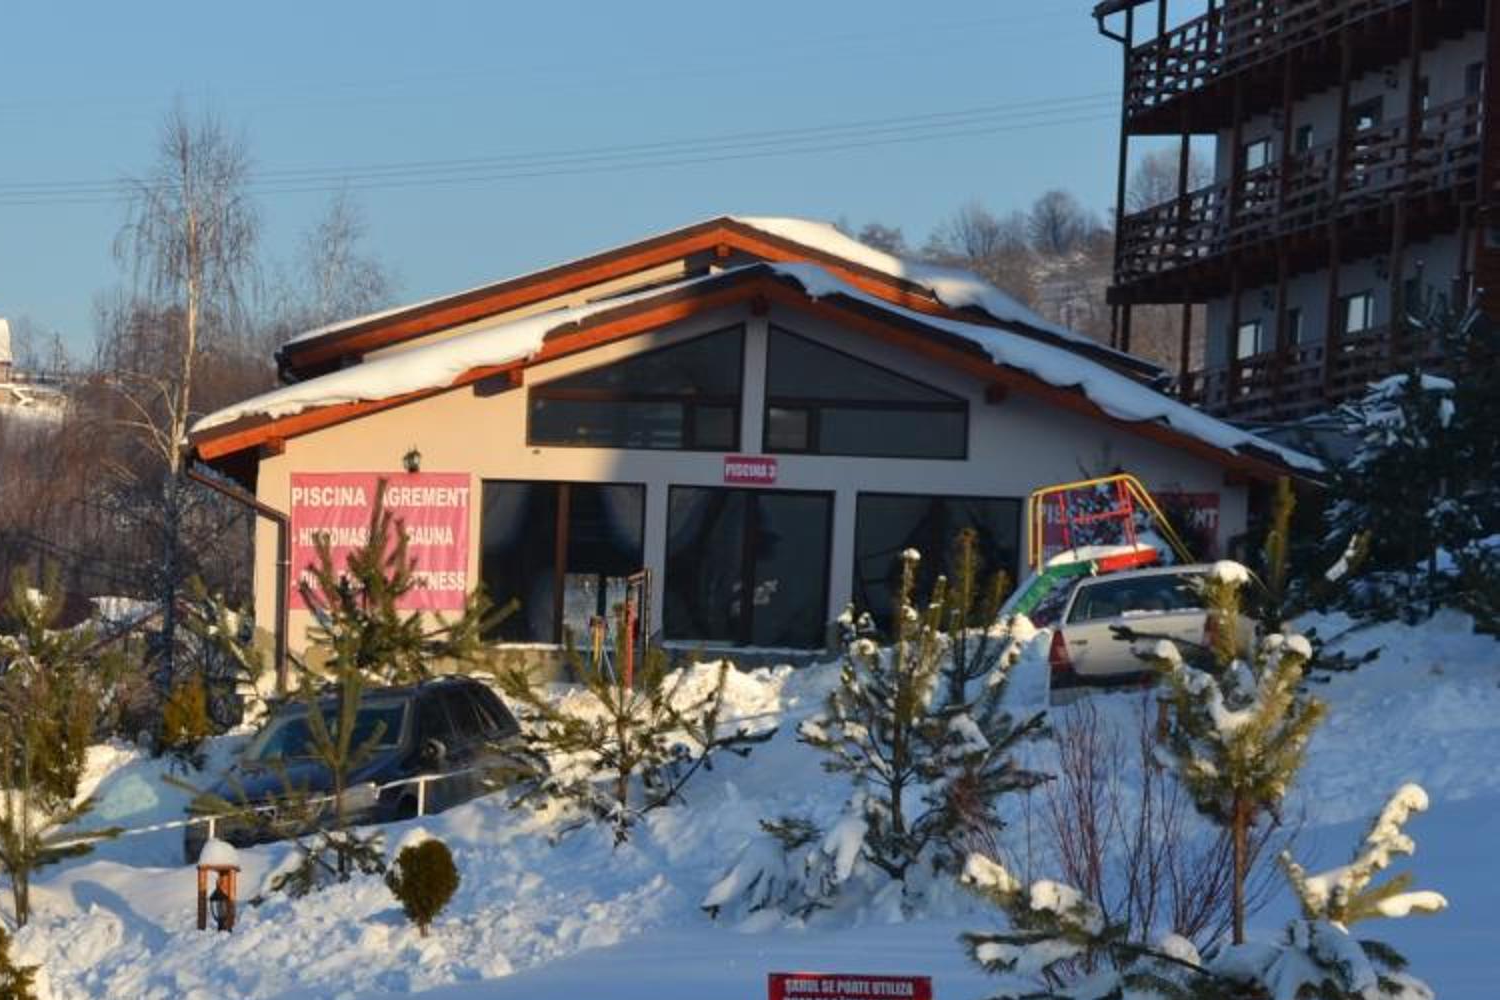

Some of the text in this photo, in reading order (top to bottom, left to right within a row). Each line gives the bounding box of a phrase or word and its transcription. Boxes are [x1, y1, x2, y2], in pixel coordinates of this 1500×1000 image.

[292, 487, 367, 507] PISCINA
[407, 527, 454, 545] SAUNA
[822, 979, 836, 993] SE
[872, 982, 914, 996] UTILIZA
